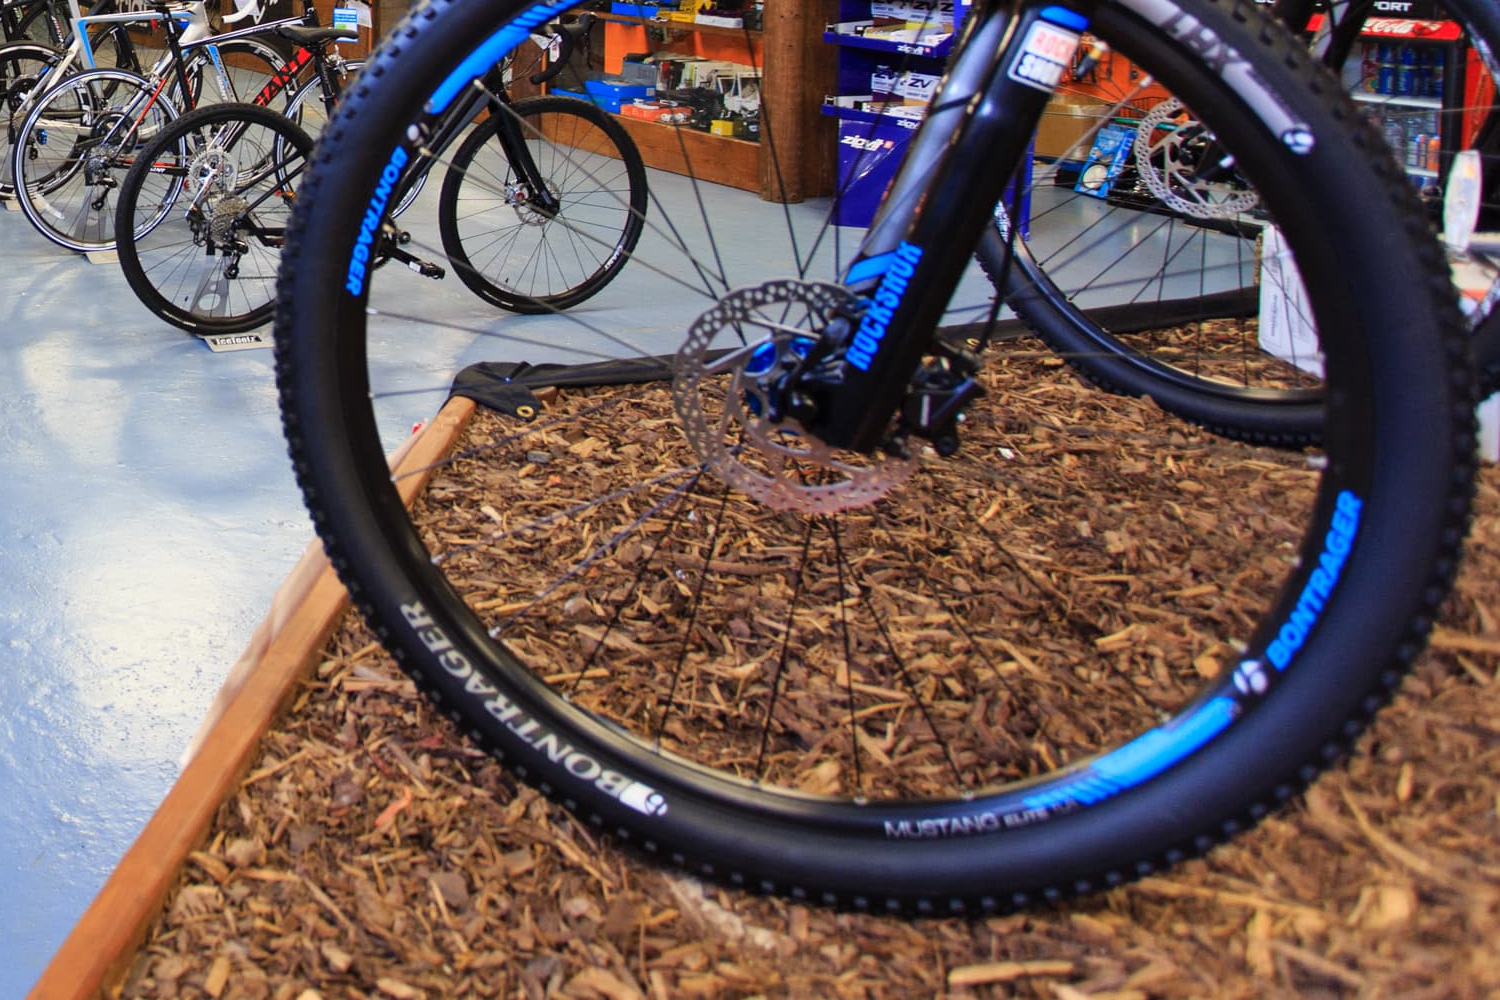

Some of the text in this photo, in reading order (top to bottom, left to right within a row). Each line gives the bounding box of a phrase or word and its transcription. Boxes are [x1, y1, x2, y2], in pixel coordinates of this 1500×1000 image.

[908, 78, 933, 89] ZV
[1032, 30, 1078, 63] ROCK
[840, 134, 884, 152] zipvit
[345, 144, 409, 297] BONTRAGER
[845, 239, 924, 372] ROCKSHOX
[1265, 488, 1364, 672] BONTRAGER
[399, 600, 633, 801] BONTRAGER
[883, 812, 1000, 840] MUSTANG
[1003, 806, 1049, 828] ELITE
